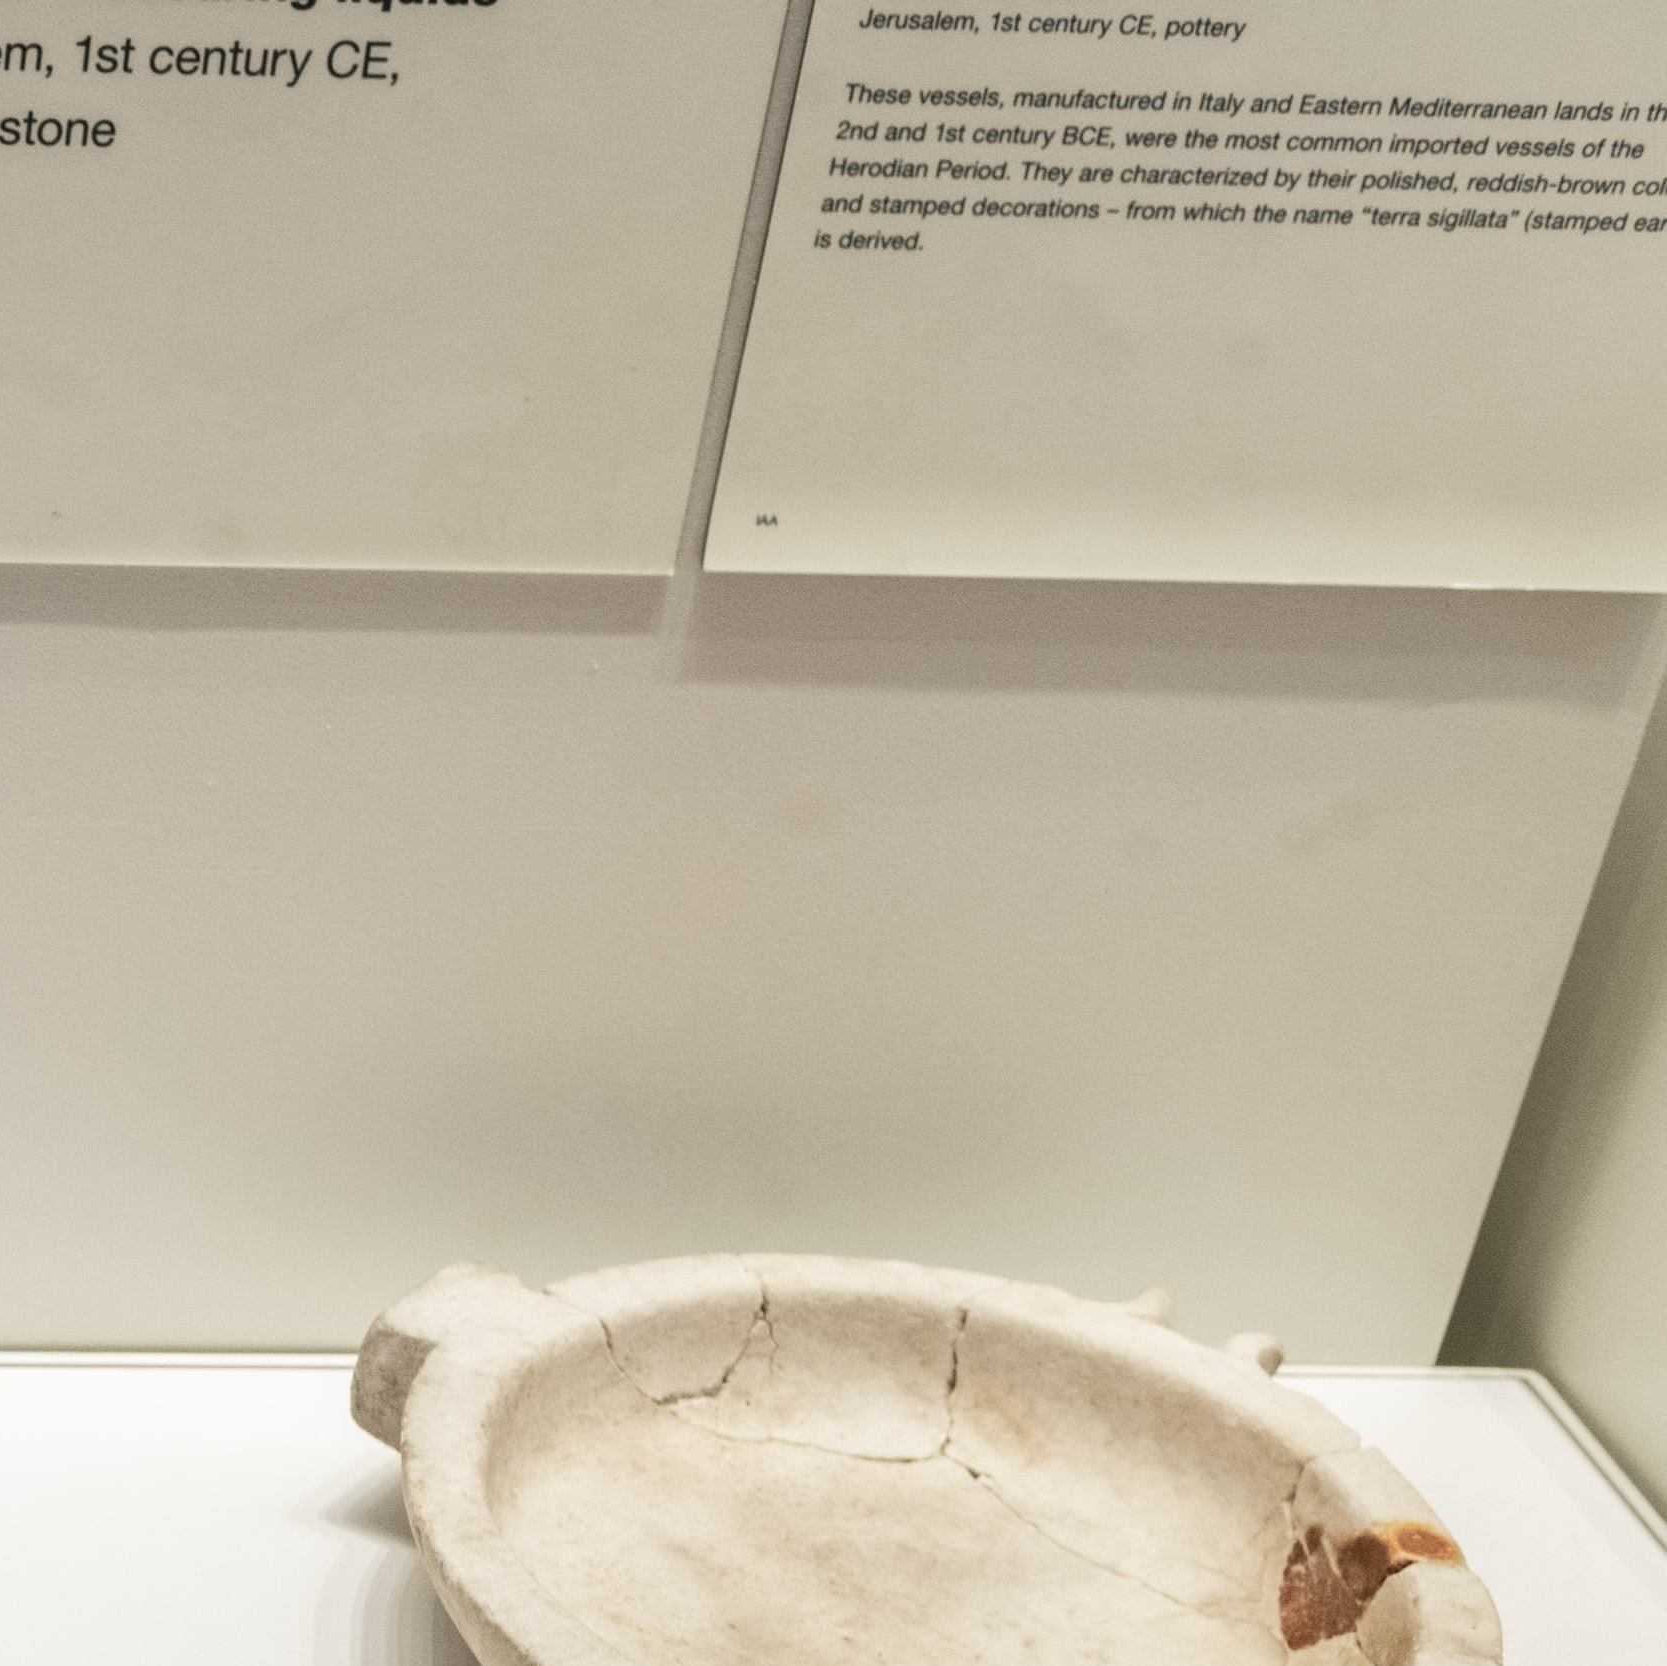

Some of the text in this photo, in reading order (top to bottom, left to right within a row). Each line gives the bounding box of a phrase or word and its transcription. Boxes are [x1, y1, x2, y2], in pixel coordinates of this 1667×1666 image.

[857, 7, 1248, 44] Jerusalem, 1st century CE, pottery
[75, 34, 136, 75] 1st
[148, 39, 314, 90] century
[325, 38, 399, 87] CE,
[845, 81, 914, 107] These
[917, 86, 1006, 110] vessels,
[1011, 87, 1169, 113] manufactured
[1170, 90, 1194, 112] in
[1197, 91, 1246, 119] Italy
[1248, 93, 1296, 116] and
[1297, 92, 1384, 117] Eastern
[1387, 95, 1550, 121] Mediterranean
[1552, 99, 1615, 123] lands
[1618, 101, 1642, 123] in
[834, 118, 1647, 161] 2nd and 1st century BCE, were the most common imported vessels of the
[827, 156, 930, 181] Herodian
[934, 157, 1011, 183] Period.
[1021, 159, 1075, 188] They
[1077, 165, 1116, 185] are
[1118, 163, 1271, 188] characterized
[1272, 167, 1303, 193] by
[1306, 168, 1358, 190] their
[1358, 170, 1459, 195] polished,
[1465, 171, 1628, 196] reddish-brown
[819, 193, 866, 215] and
[867, 194, 968, 220] stamped
[970, 196, 1102, 221] decorations
[1124, 198, 1178, 223] from
[1182, 201, 1248, 225] which
[1251, 203, 1289, 226] the
[1291, 207, 1355, 227] name
[1361, 205, 1423, 228] “terra
[1425, 207, 1522, 234] sigillata”
[1522, 209, 1631, 236] (stamped
[812, 229, 924, 253] is derived.
[755, 514, 779, 527] IAA
